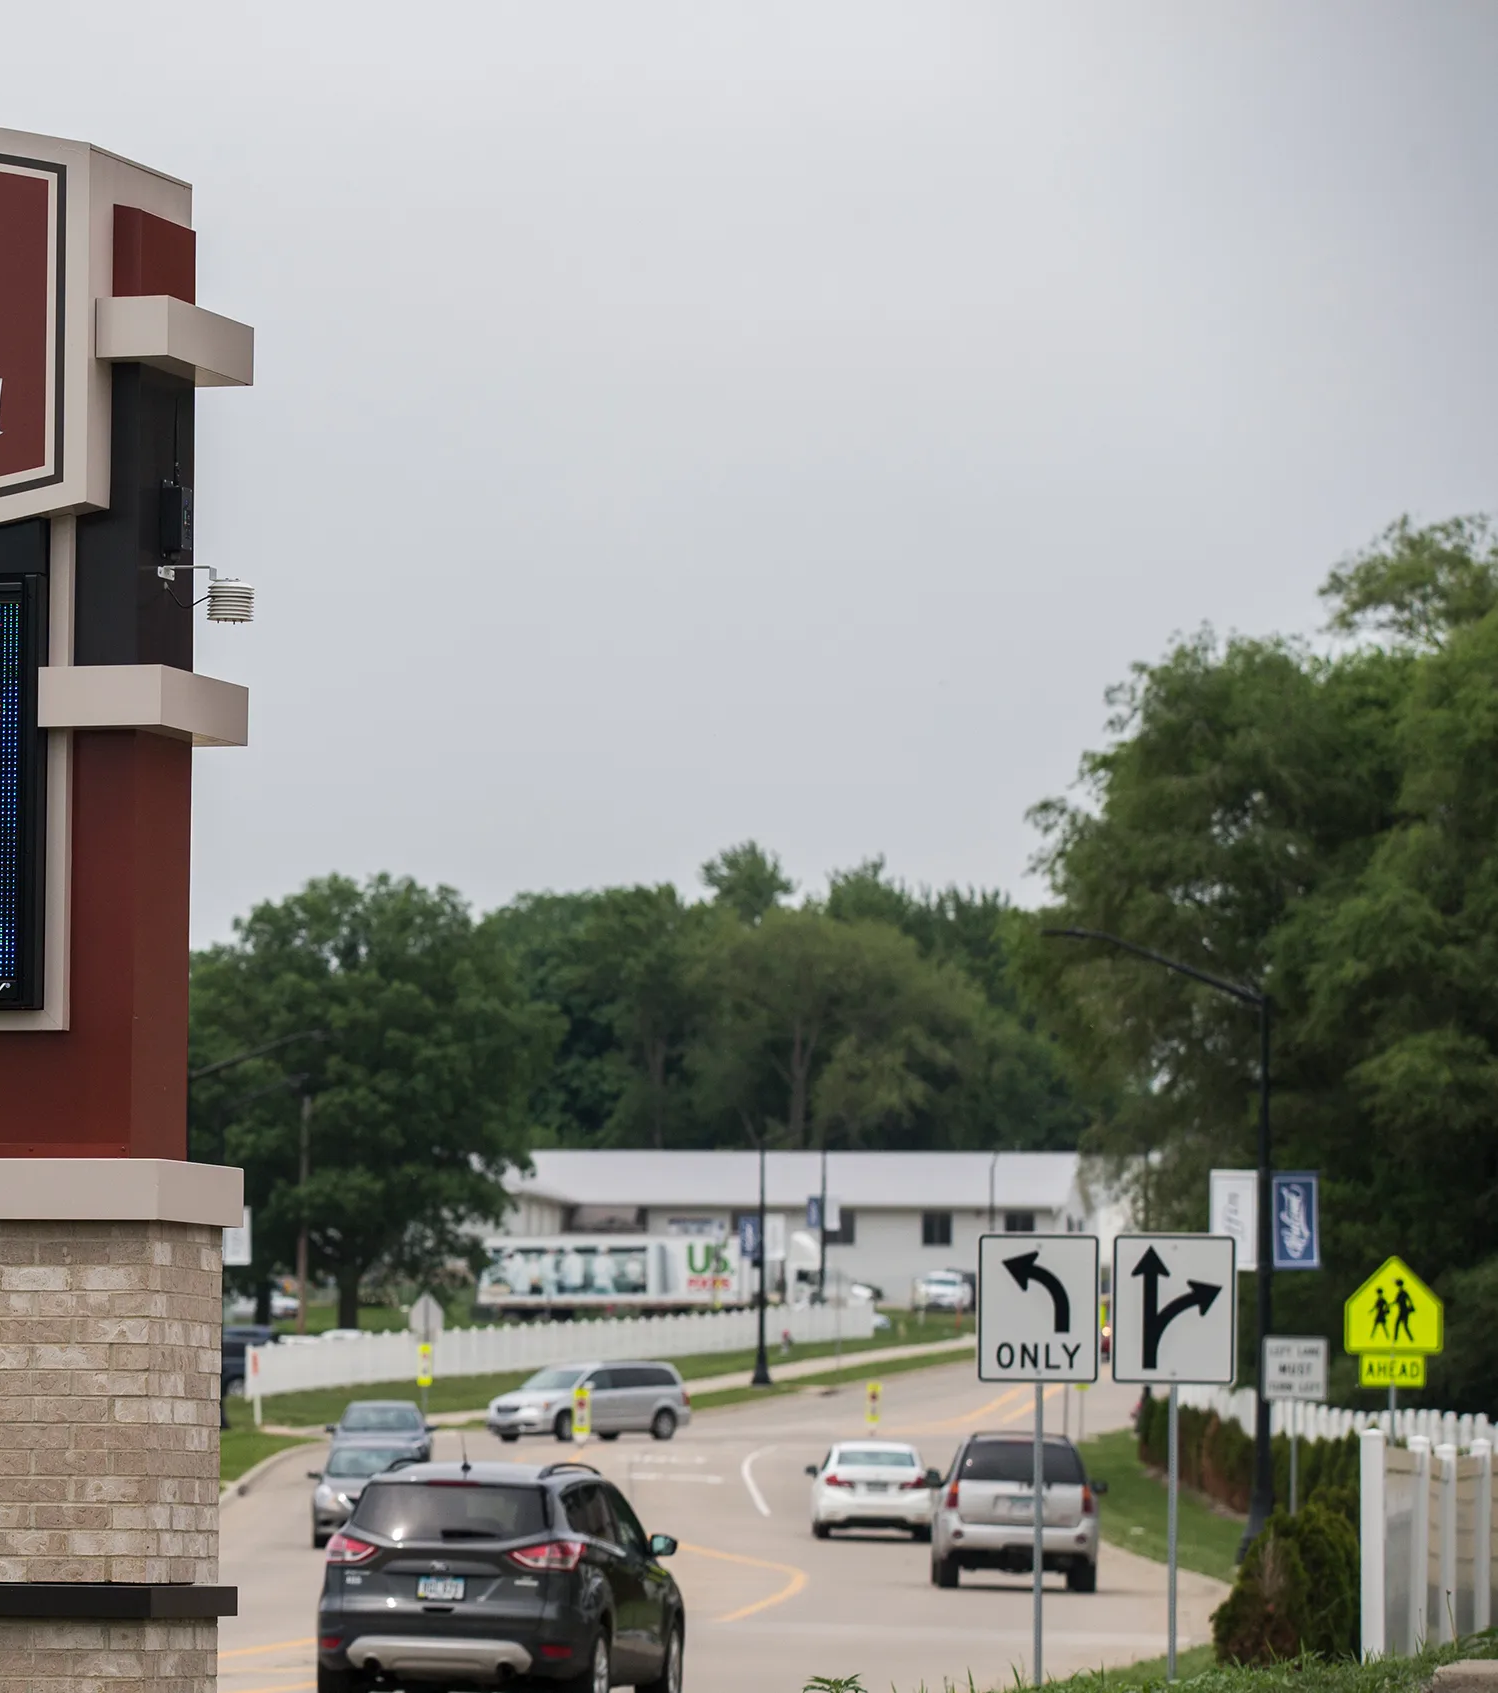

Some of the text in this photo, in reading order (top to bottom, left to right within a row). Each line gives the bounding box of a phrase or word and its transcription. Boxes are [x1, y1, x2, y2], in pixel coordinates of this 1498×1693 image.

[996, 1342, 1082, 1370] ONLY
[1278, 1362, 1313, 1377] MUST
[1365, 1361, 1420, 1379] AHEAD
